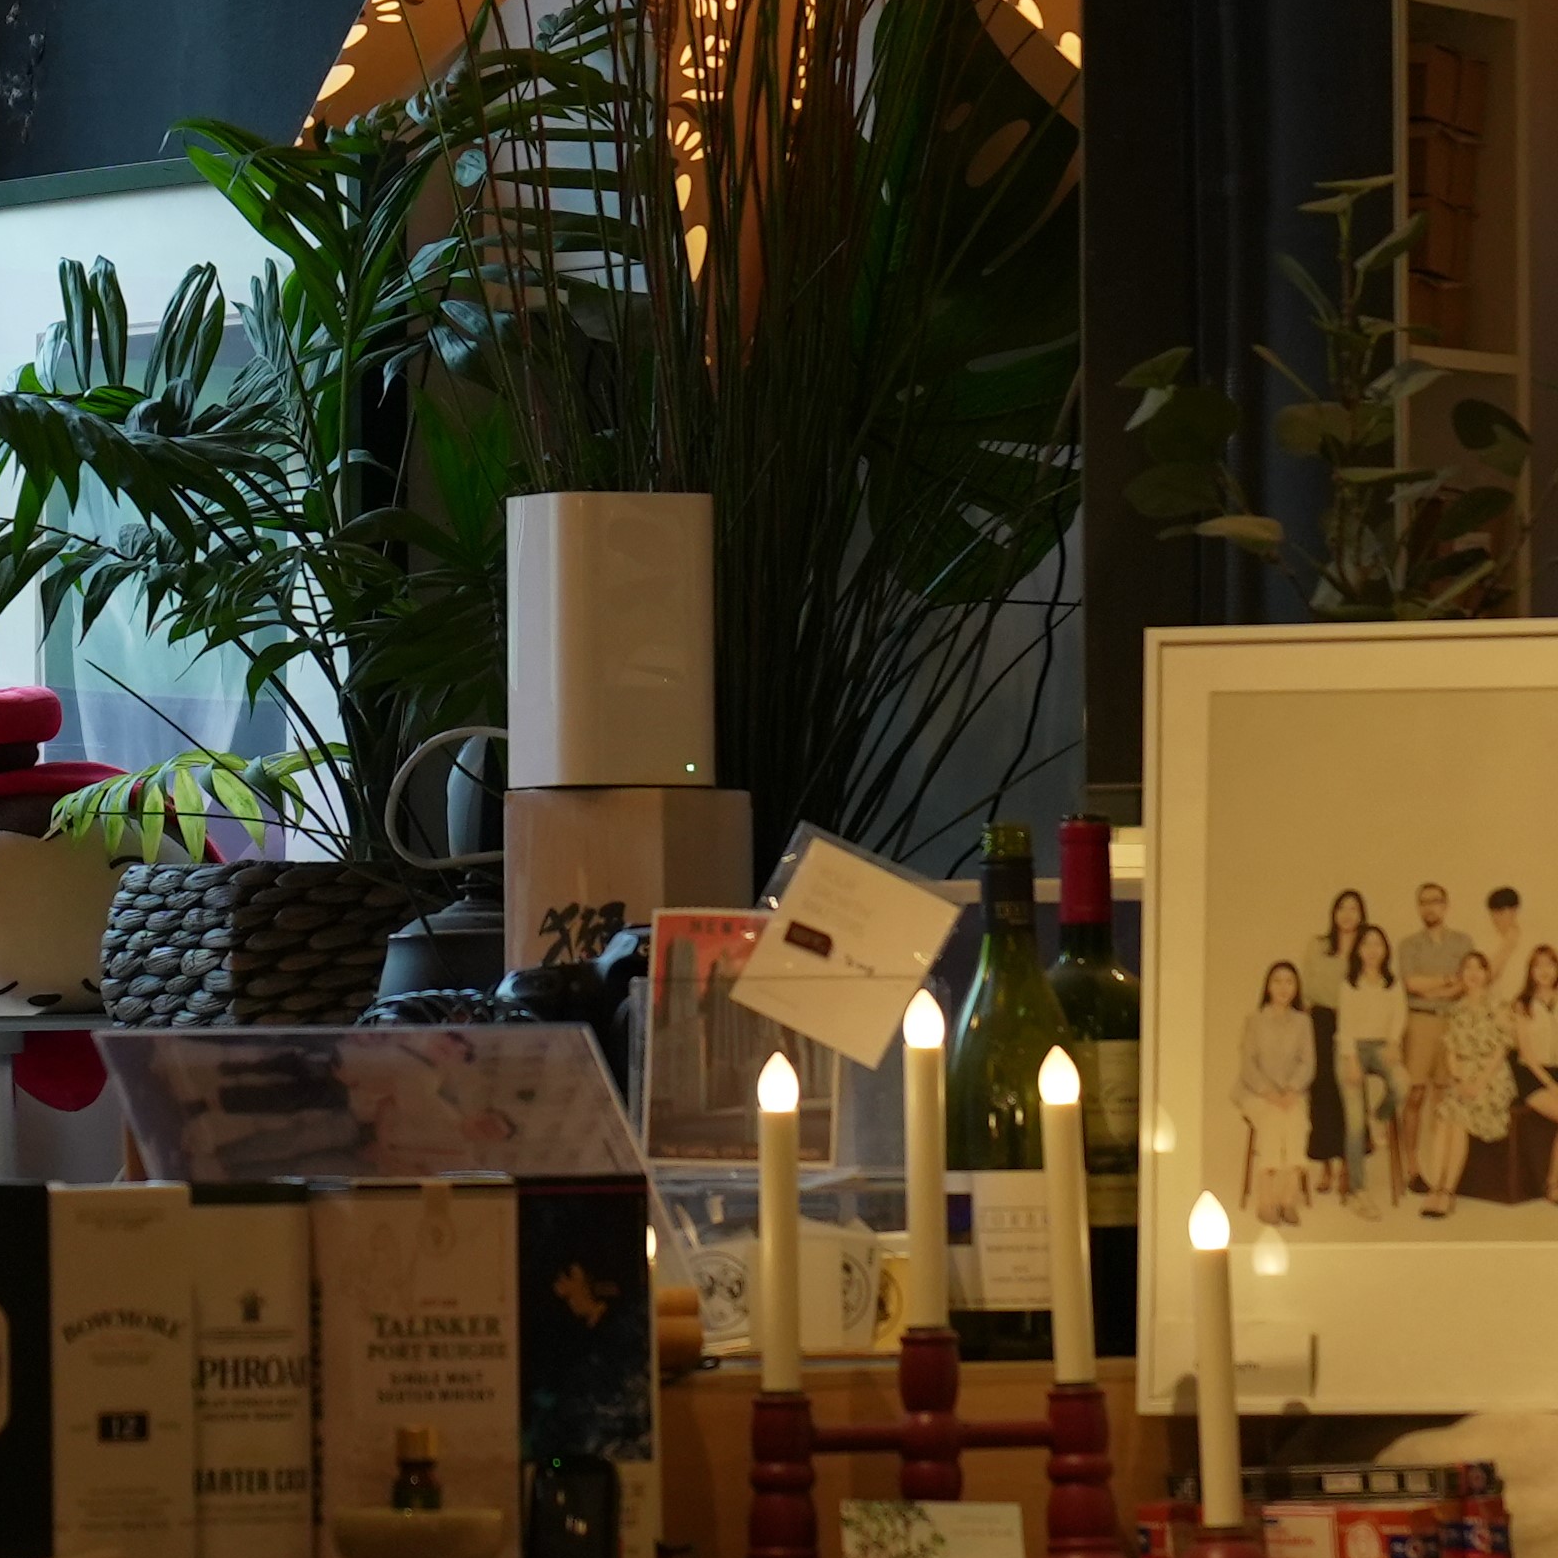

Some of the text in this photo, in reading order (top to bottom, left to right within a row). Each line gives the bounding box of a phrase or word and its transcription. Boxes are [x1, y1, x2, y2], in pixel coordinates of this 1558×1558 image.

[61, 1308, 186, 1344] BOWMORE
[372, 1314, 501, 1339] TALISKER
[368, 1341, 422, 1361] PORT
[389, 1370, 484, 1386] SINGLE MALT
[376, 1386, 433, 1403] SCOTCH
[111, 1415, 138, 1436] 12
